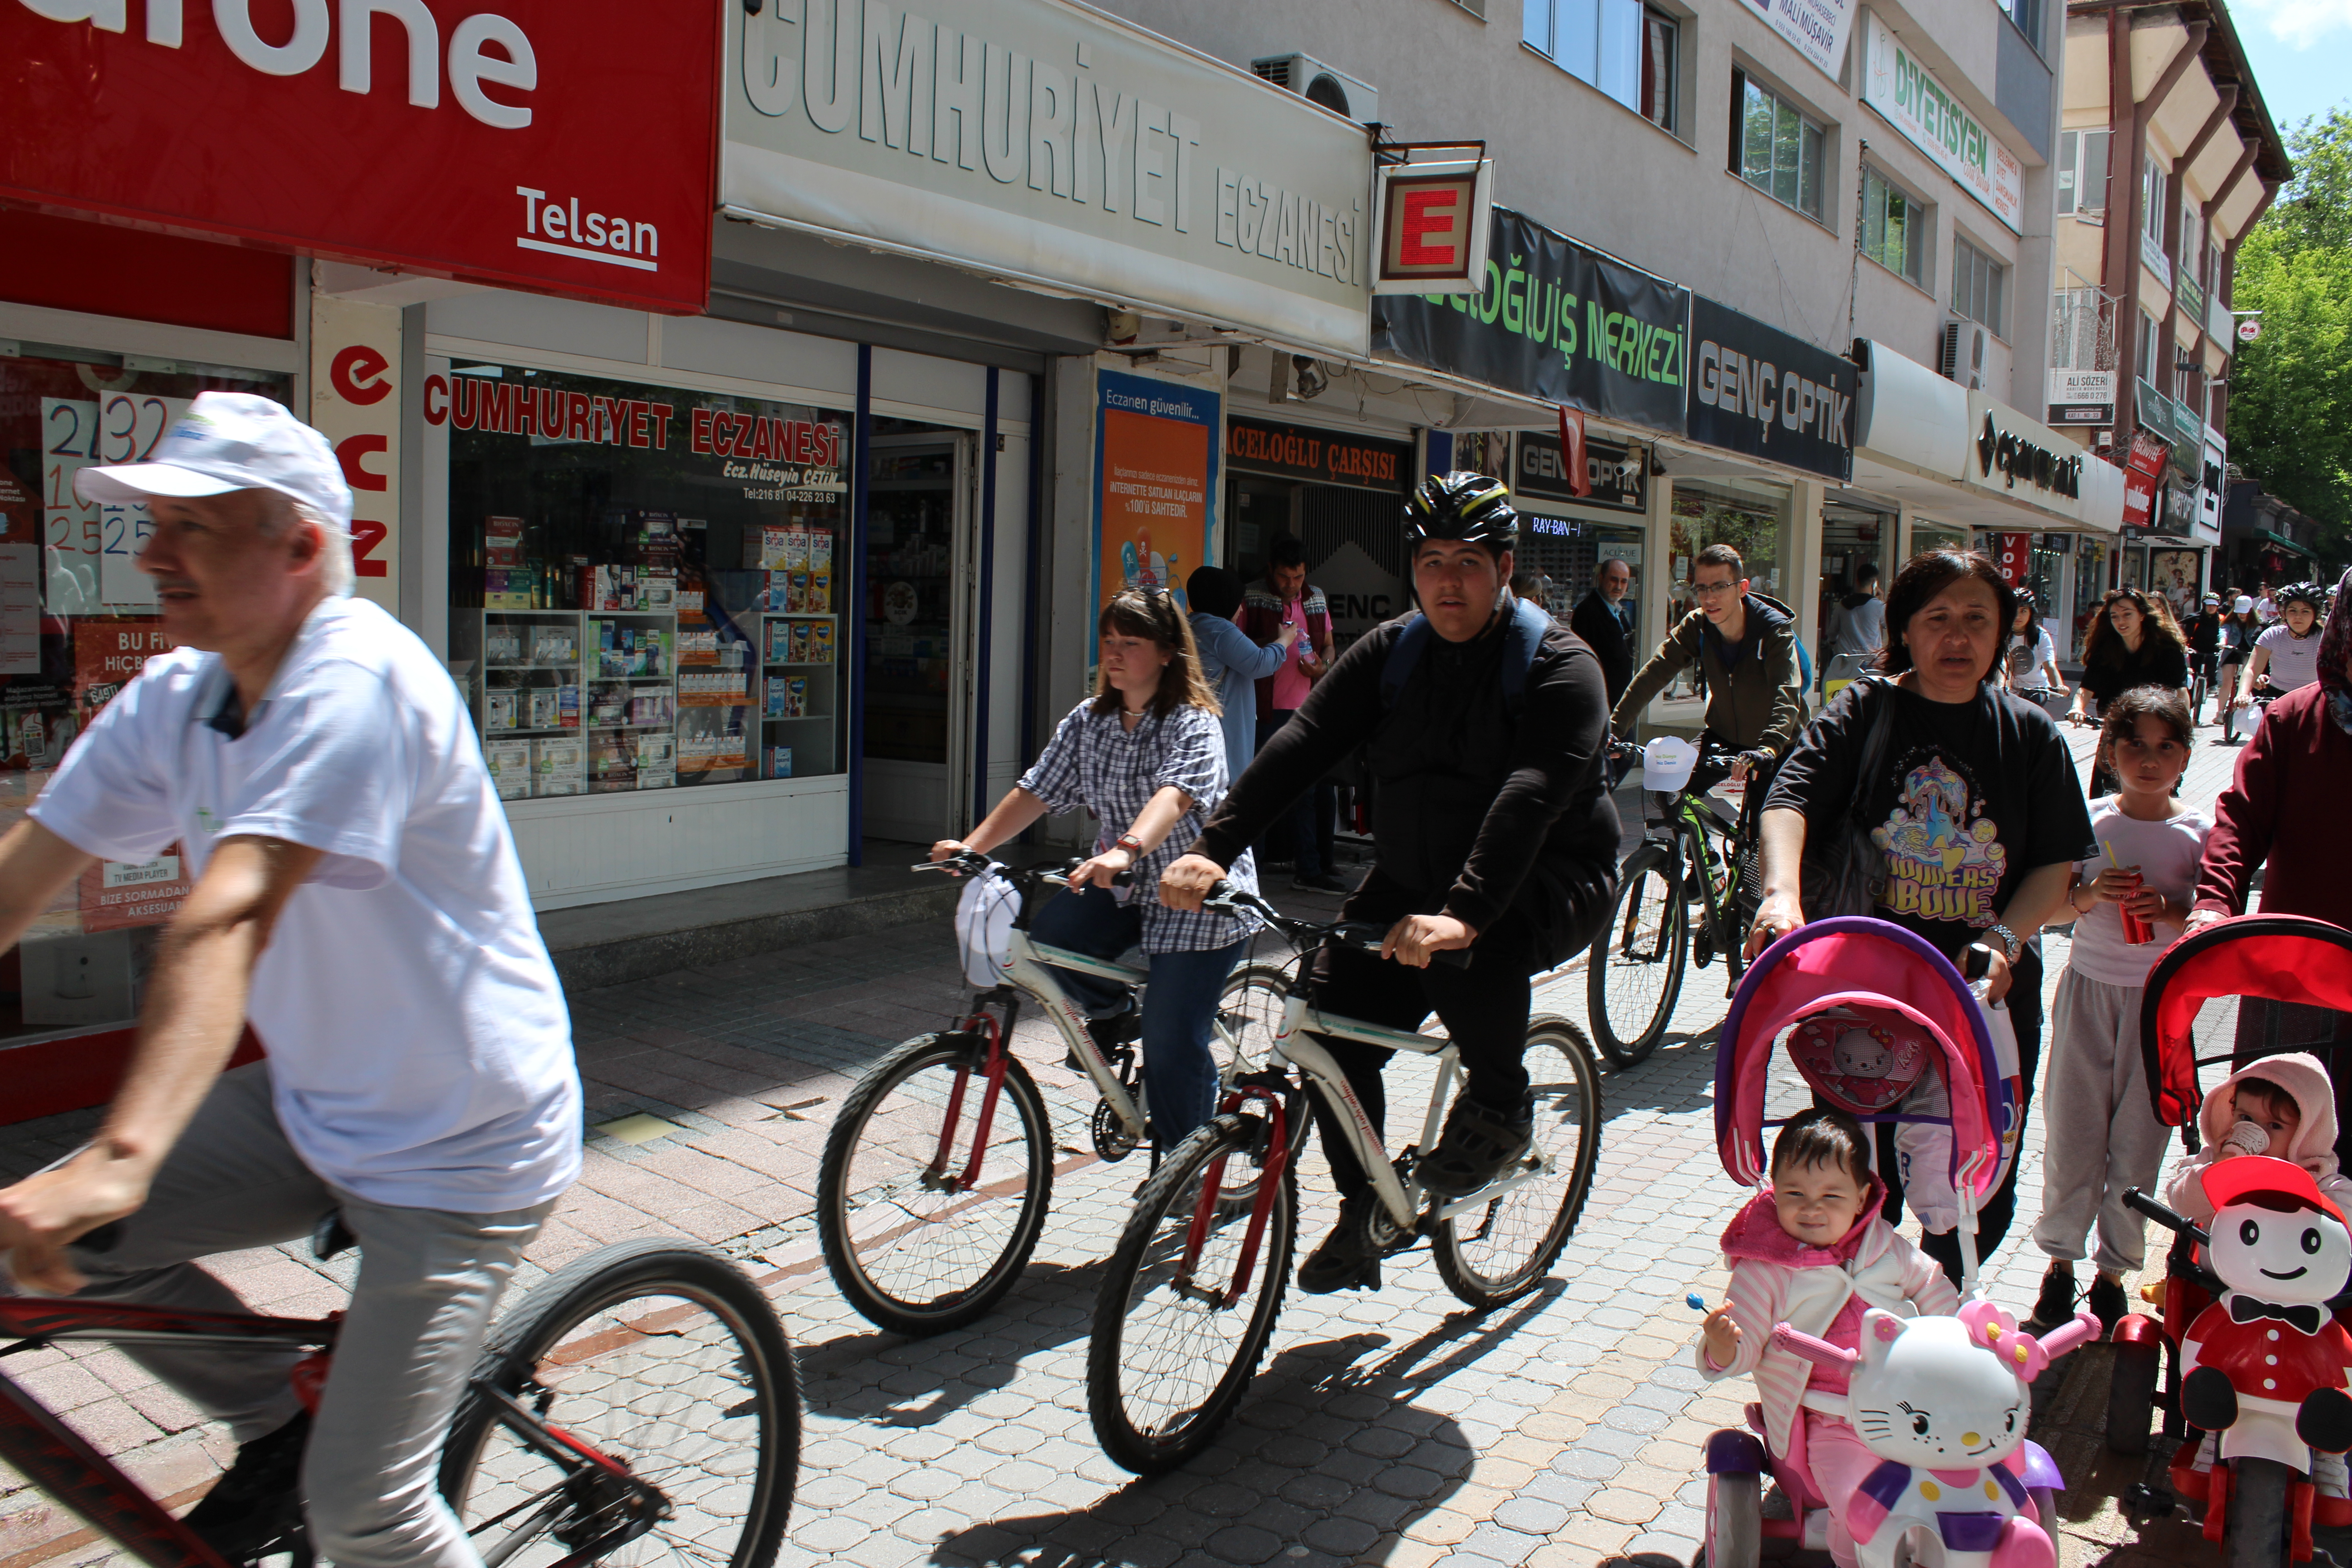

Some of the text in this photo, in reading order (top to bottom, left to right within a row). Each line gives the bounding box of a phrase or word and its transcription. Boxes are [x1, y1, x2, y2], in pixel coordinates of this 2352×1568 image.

[1779, 0, 1833, 54] MALİ MÜŞAVİR
[1895, 47, 1987, 176] DİYETİSYEN
[741, 0, 1361, 287] CUMHURİYET ECZANESİ
[516, 186, 658, 257] Telsan
[1400, 189, 1458, 266] E
[1587, 300, 1683, 387] MERKEZİ
[1697, 339, 1851, 448] GENÇ OPTİK
[2067, 375, 2107, 386] ALİ SÖZERİ
[1107, 389, 1199, 419] Eczanen güvenilir...
[49, 405, 100, 459] 2
[424, 374, 839, 468] CUMHURİYET ECZANESİ
[1327, 444, 1396, 485] ÇARŞISI
[1523, 444, 1568, 480] GEN
[2133, 438, 2161, 462] TEKNOTEL
[723, 460, 748, 478] Ecz.
[750, 462, 799, 487] Hüseyin
[1138, 470, 1155, 481] sadece
[743, 487, 835, 503] Tel:216 81 04-226 23 63
[1148, 485, 1173, 500] SATILAN
[1174, 489, 1202, 503] İLAÇLARIN
[1152, 501, 1187, 518] SAHTEDİR.
[813, 536, 829, 549] sma
[1328, 593, 1391, 623] ENÇ
[119, 632, 142, 650] BU
[105, 656, 147, 673] HİÇB
[114, 869, 168, 882] TV MEDIA PLAYER
[100, 886, 190, 906] BİZE SORMADAN
